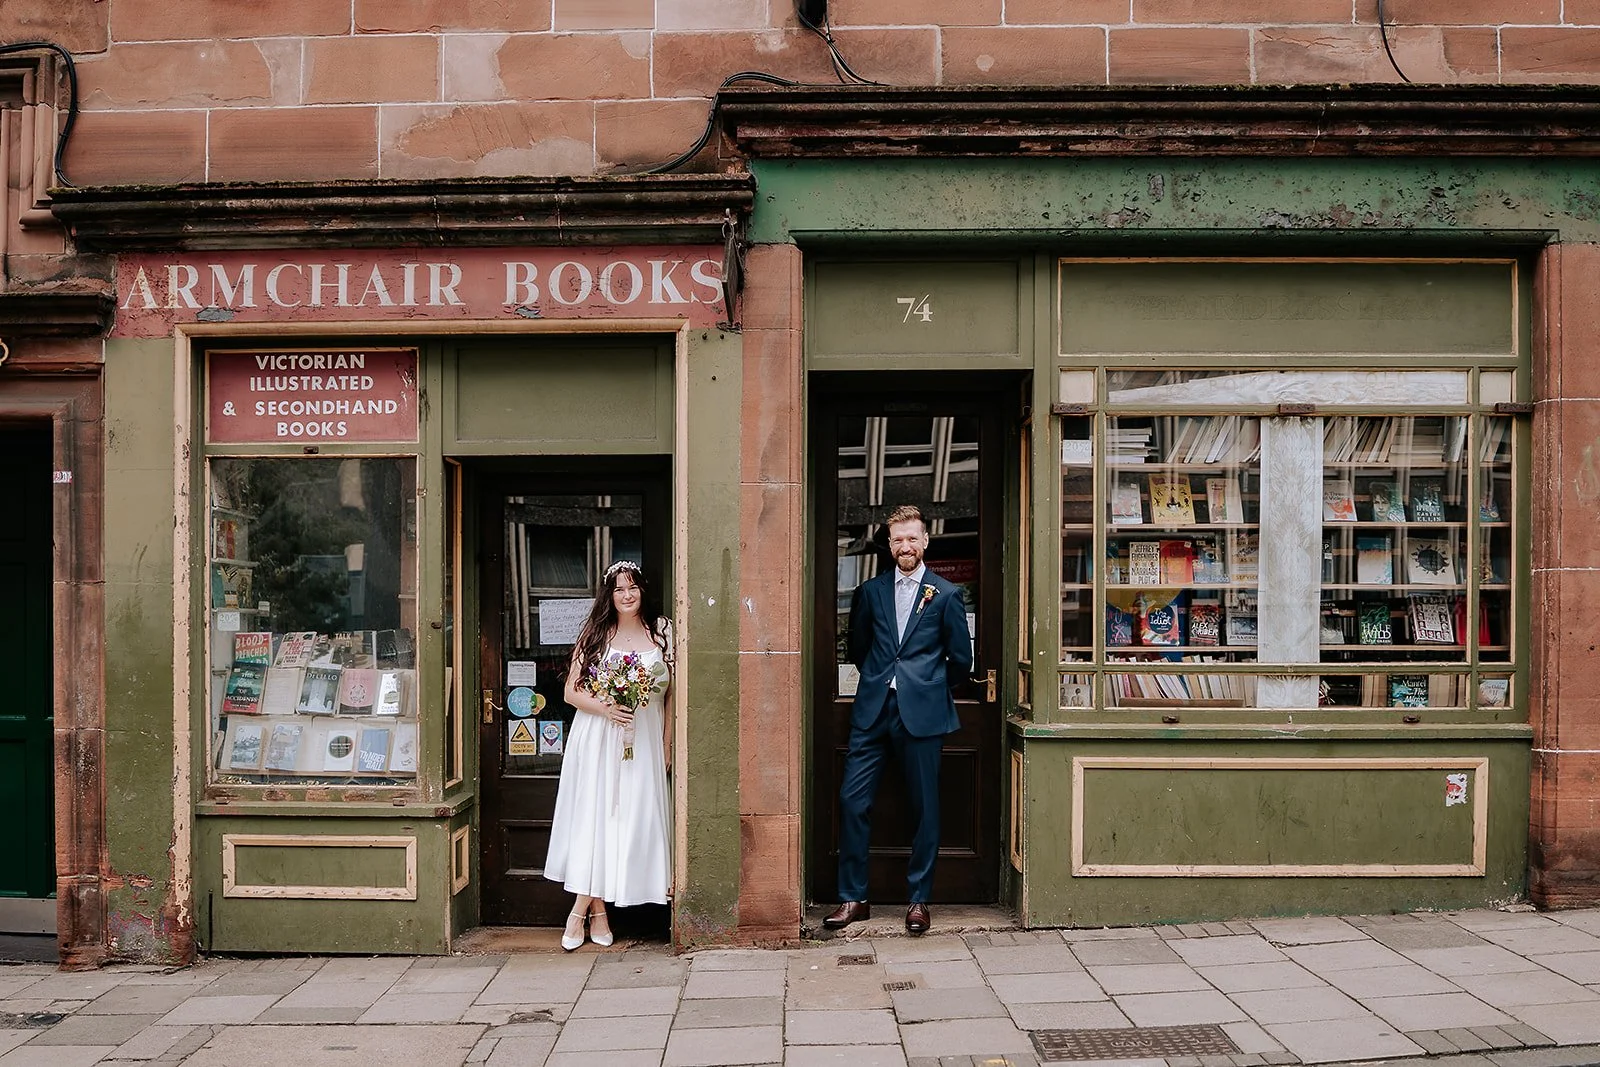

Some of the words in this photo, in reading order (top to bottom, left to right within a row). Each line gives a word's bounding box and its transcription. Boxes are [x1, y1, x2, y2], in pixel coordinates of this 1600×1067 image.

[119, 262, 466, 311] ARMCHAIR
[502, 259, 727, 307] BOOKS
[897, 294, 933, 323] 74
[254, 353, 366, 372] VICTORIAN
[249, 374, 375, 392] ILLUSTRATED
[222, 401, 237, 417] &
[254, 399, 398, 418] SECONDHAND
[276, 420, 349, 437] BOOKS
[1150, 615, 1172, 626] Idiot
[1362, 622, 1392, 633] HALF
[235, 635, 269, 650] BLOOD-
[1362, 629, 1392, 640] WILD
